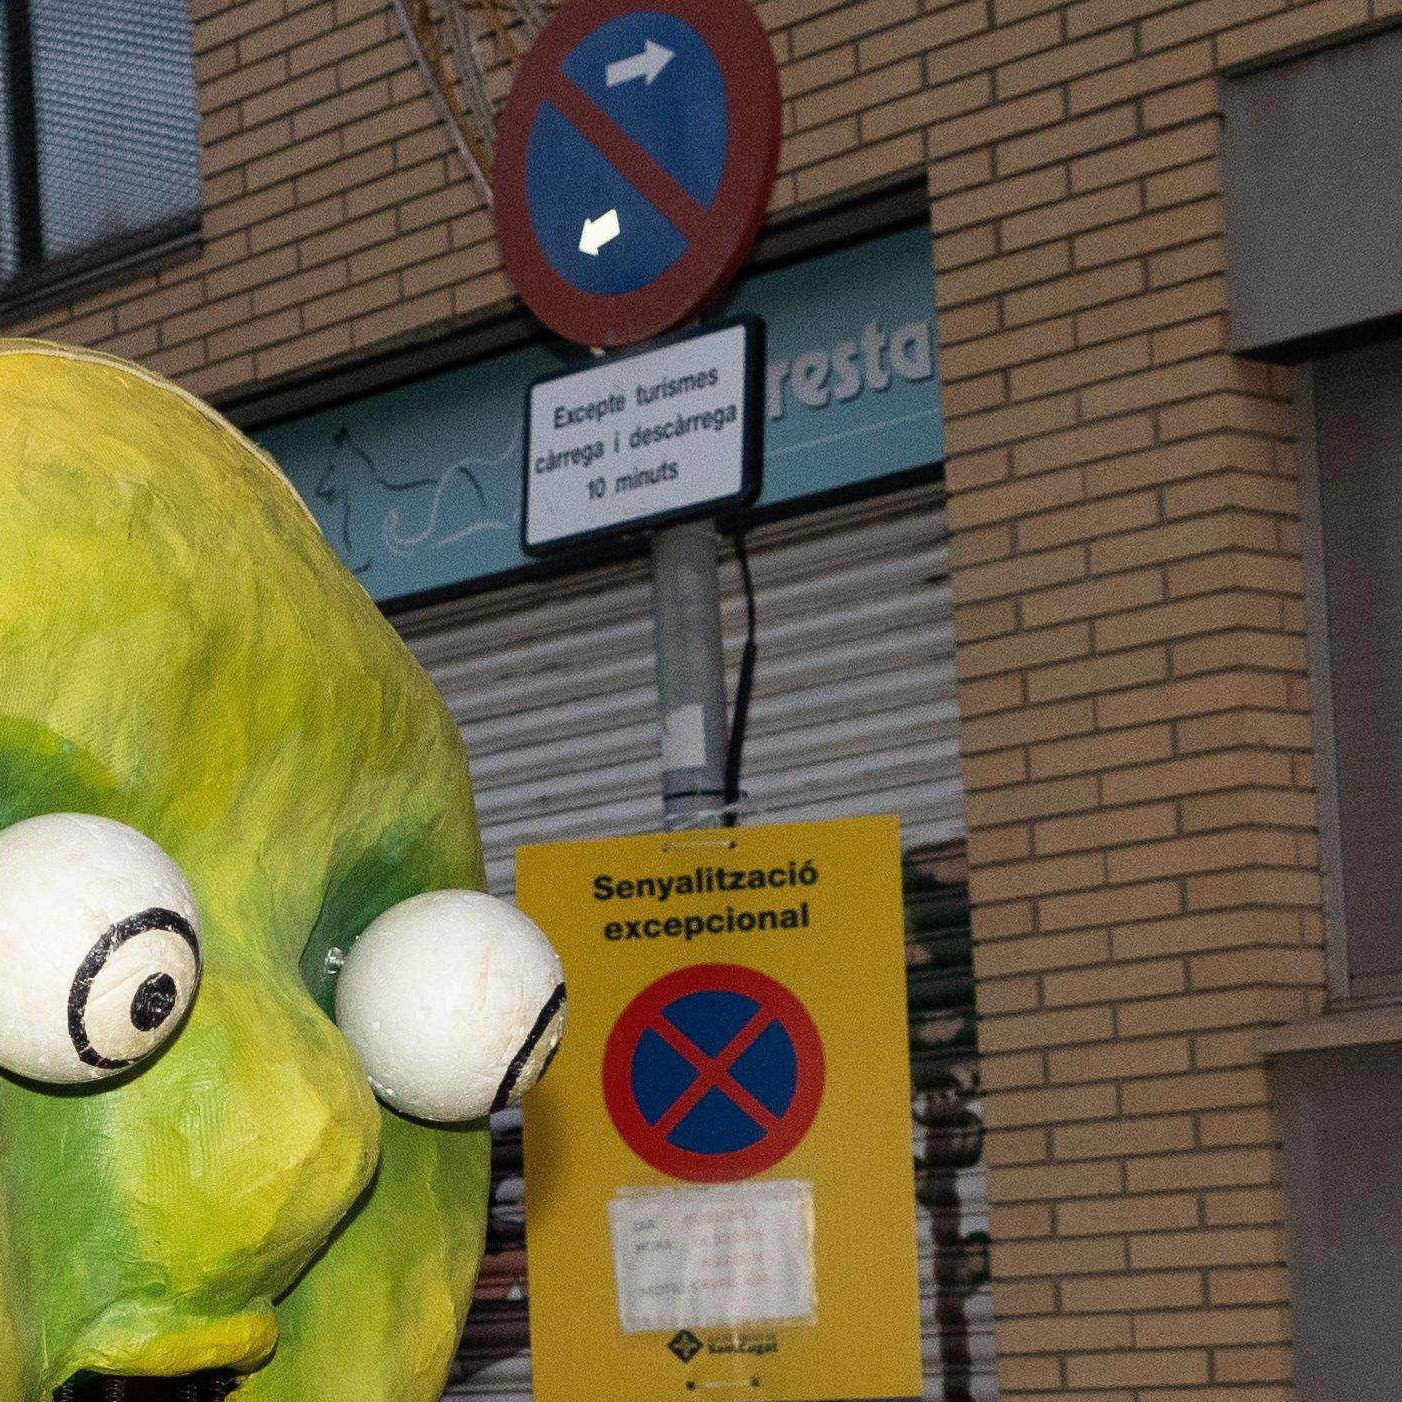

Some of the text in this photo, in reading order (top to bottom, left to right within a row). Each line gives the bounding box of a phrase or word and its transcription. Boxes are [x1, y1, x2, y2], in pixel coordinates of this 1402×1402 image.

[553, 367, 718, 430] Excepte turismes
[613, 429, 620, 453] i
[587, 460, 679, 500] 10 minuts
[593, 858, 819, 901] Senyalització
[603, 900, 810, 941] excepcional
